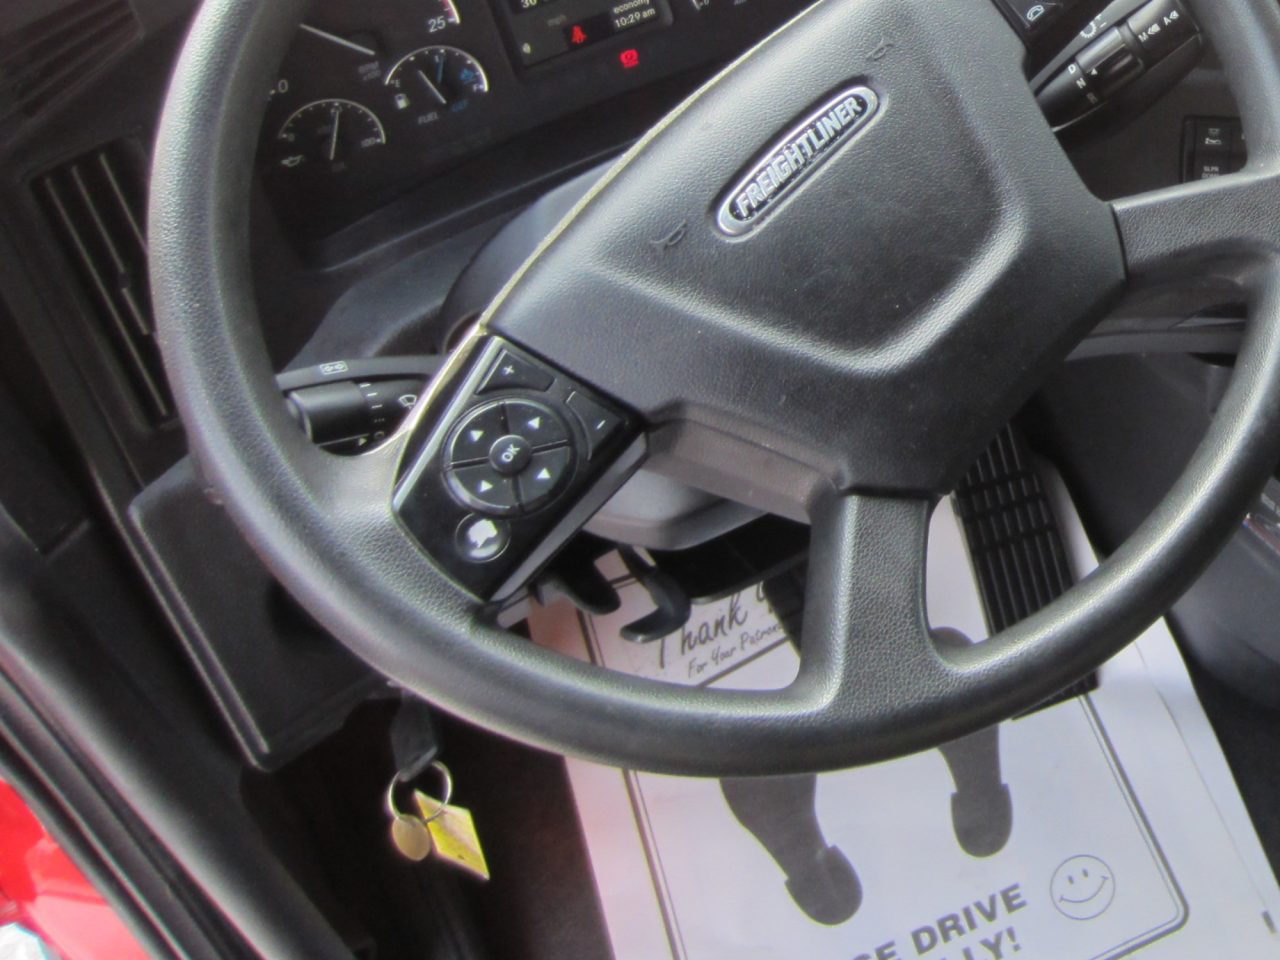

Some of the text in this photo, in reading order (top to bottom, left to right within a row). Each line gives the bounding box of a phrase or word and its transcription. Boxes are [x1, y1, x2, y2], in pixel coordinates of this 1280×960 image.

[428, 15, 446, 33] 25
[614, 7, 656, 28] 10:29 am
[278, 79, 289, 93] 0
[735, 96, 863, 218] FREIGHTLINER
[501, 443, 521, 464] OK
[688, 658, 708, 678] For
[711, 645, 737, 666] Your
[911, 882, 1028, 956] DRIVE
